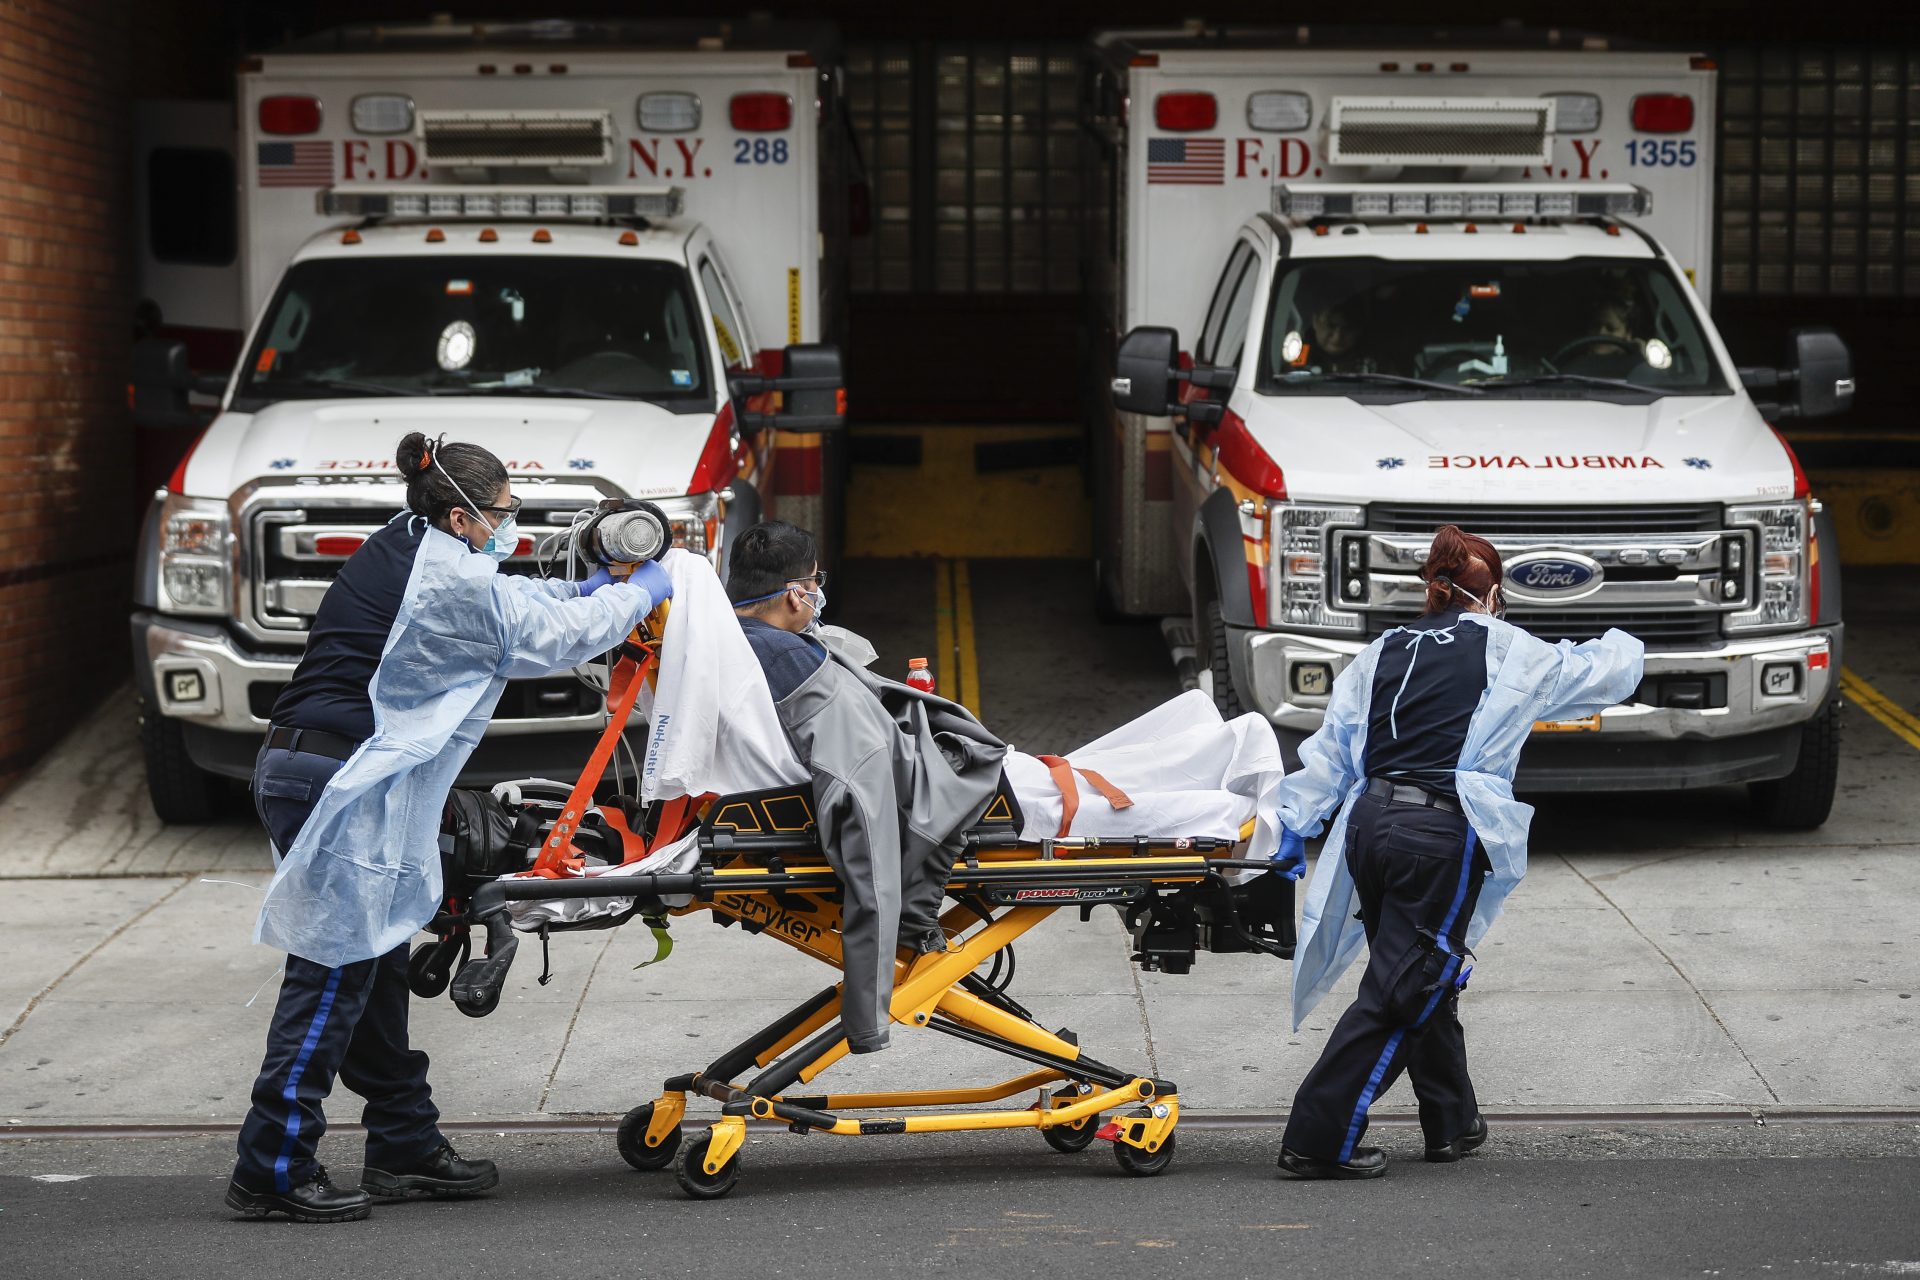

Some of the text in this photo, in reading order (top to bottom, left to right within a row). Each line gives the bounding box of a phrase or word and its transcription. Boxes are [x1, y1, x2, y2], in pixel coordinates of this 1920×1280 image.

[343, 138, 712, 180] F.D. N.Y.
[734, 138, 789, 164] 288
[1236, 138, 1322, 178] F.D.
[1625, 139, 1697, 167] 1355
[1525, 563, 1577, 585] Ford
[646, 714, 671, 775] NuHealth
[1016, 888, 1079, 900] power
[720, 893, 822, 943] stryker
